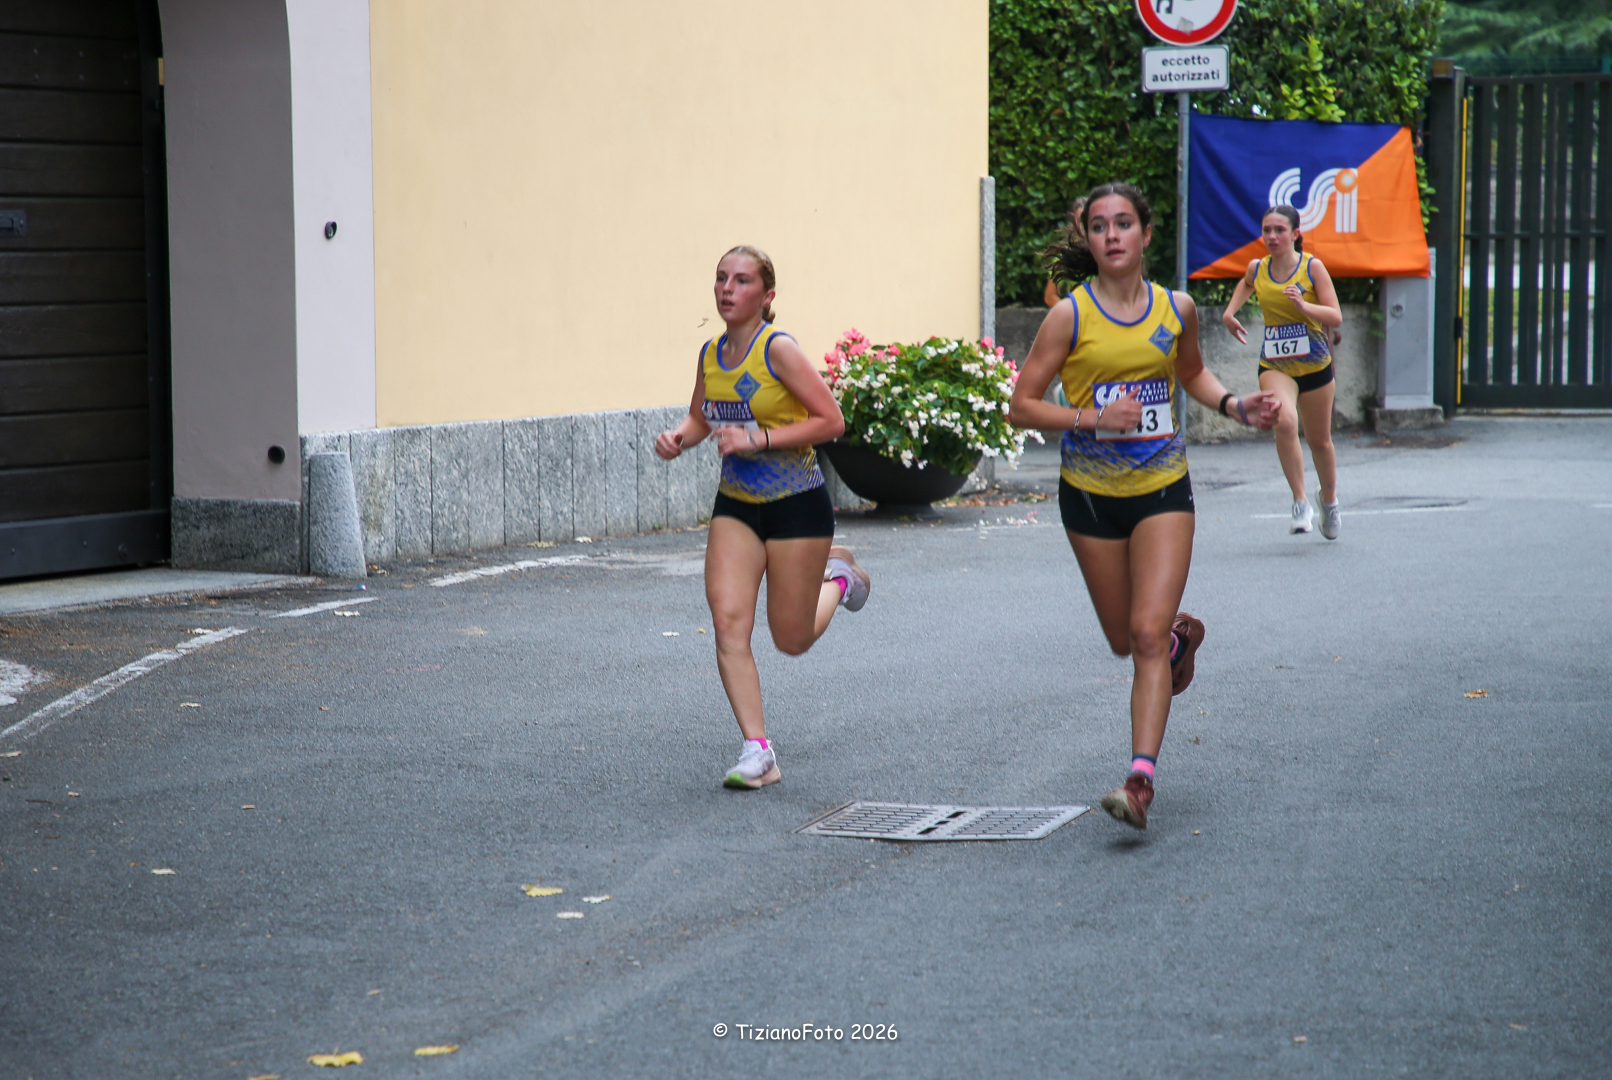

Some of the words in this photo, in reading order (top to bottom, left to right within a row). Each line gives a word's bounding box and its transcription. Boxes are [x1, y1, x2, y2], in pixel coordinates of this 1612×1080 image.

[1161, 54, 1211, 67] eccetto
[1151, 69, 1220, 82] autorizzati
[1272, 339, 1299, 355] 167
